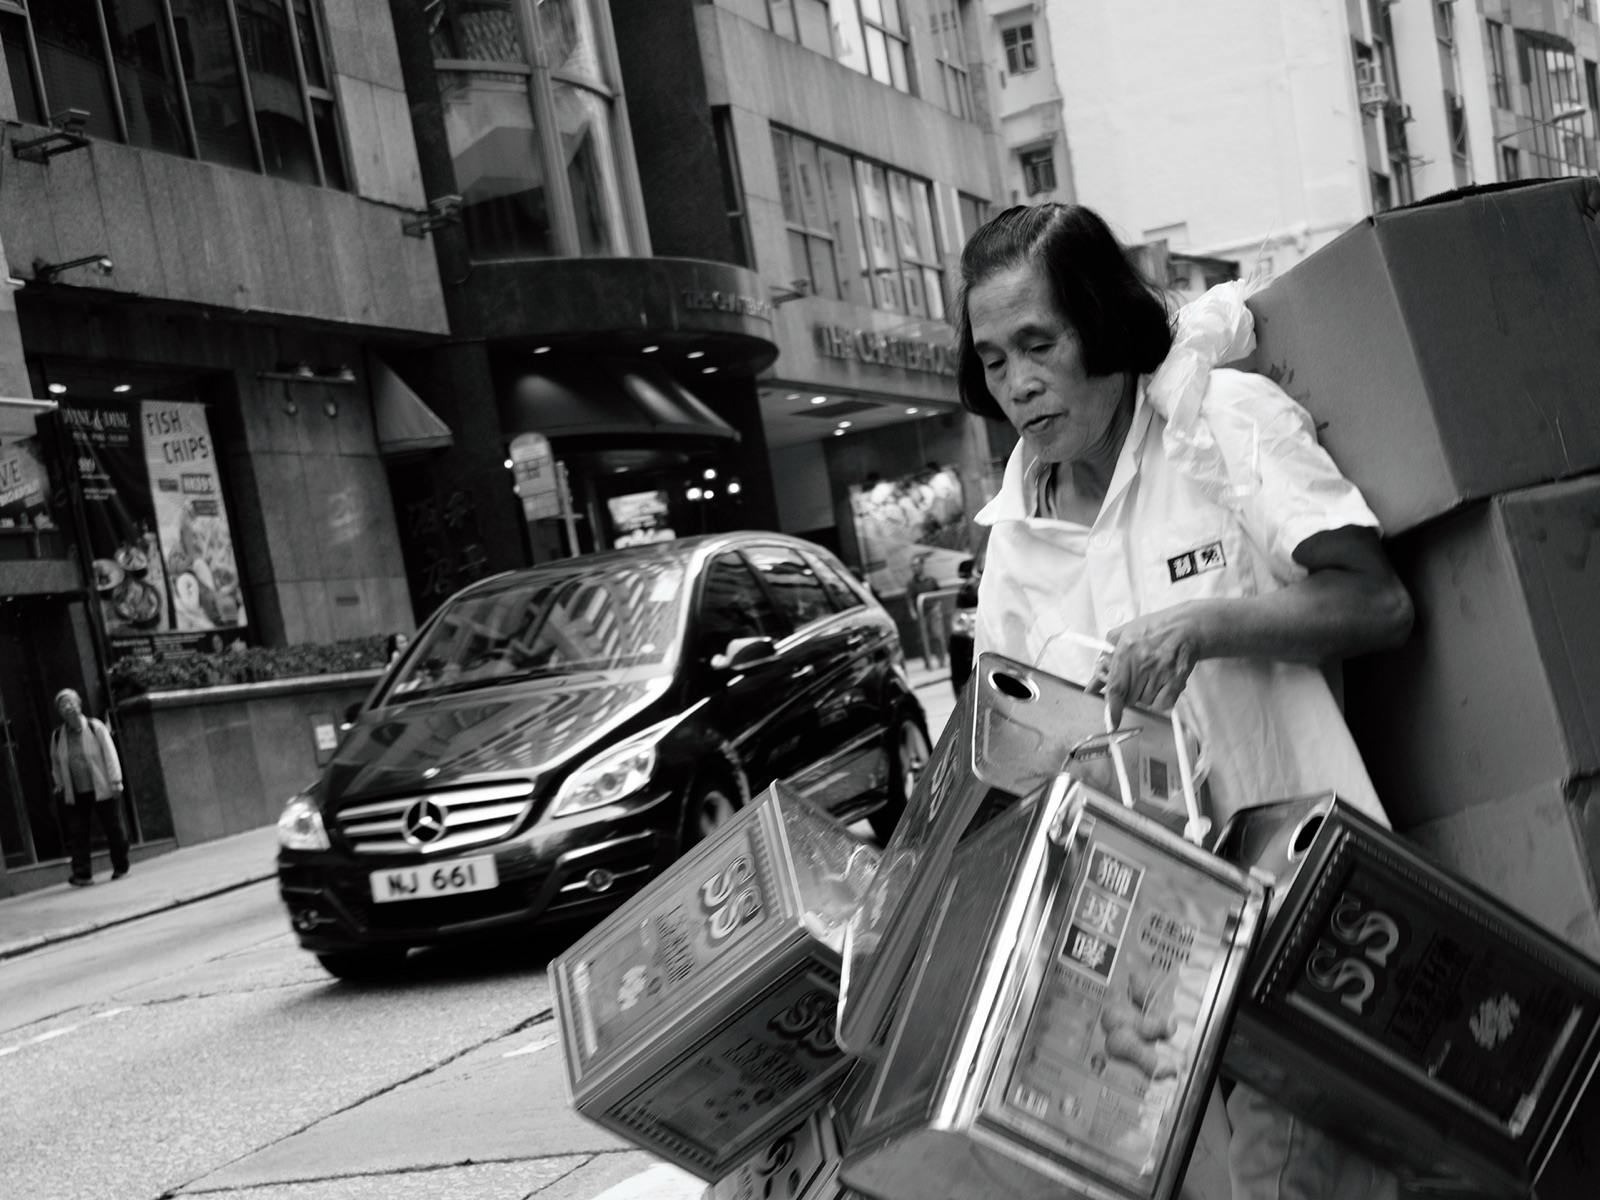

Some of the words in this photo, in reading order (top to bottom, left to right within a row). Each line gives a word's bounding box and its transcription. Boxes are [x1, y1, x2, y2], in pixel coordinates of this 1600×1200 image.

[818, 323, 855, 360] THE
[147, 410, 182, 436] FISH
[162, 437, 209, 464] CHIPS
[387, 872, 419, 896] NJ
[432, 864, 477, 890] 661
[701, 852, 763, 940] SS
[1140, 928, 1192, 963] Peanut
[1305, 893, 1400, 1016] SS
